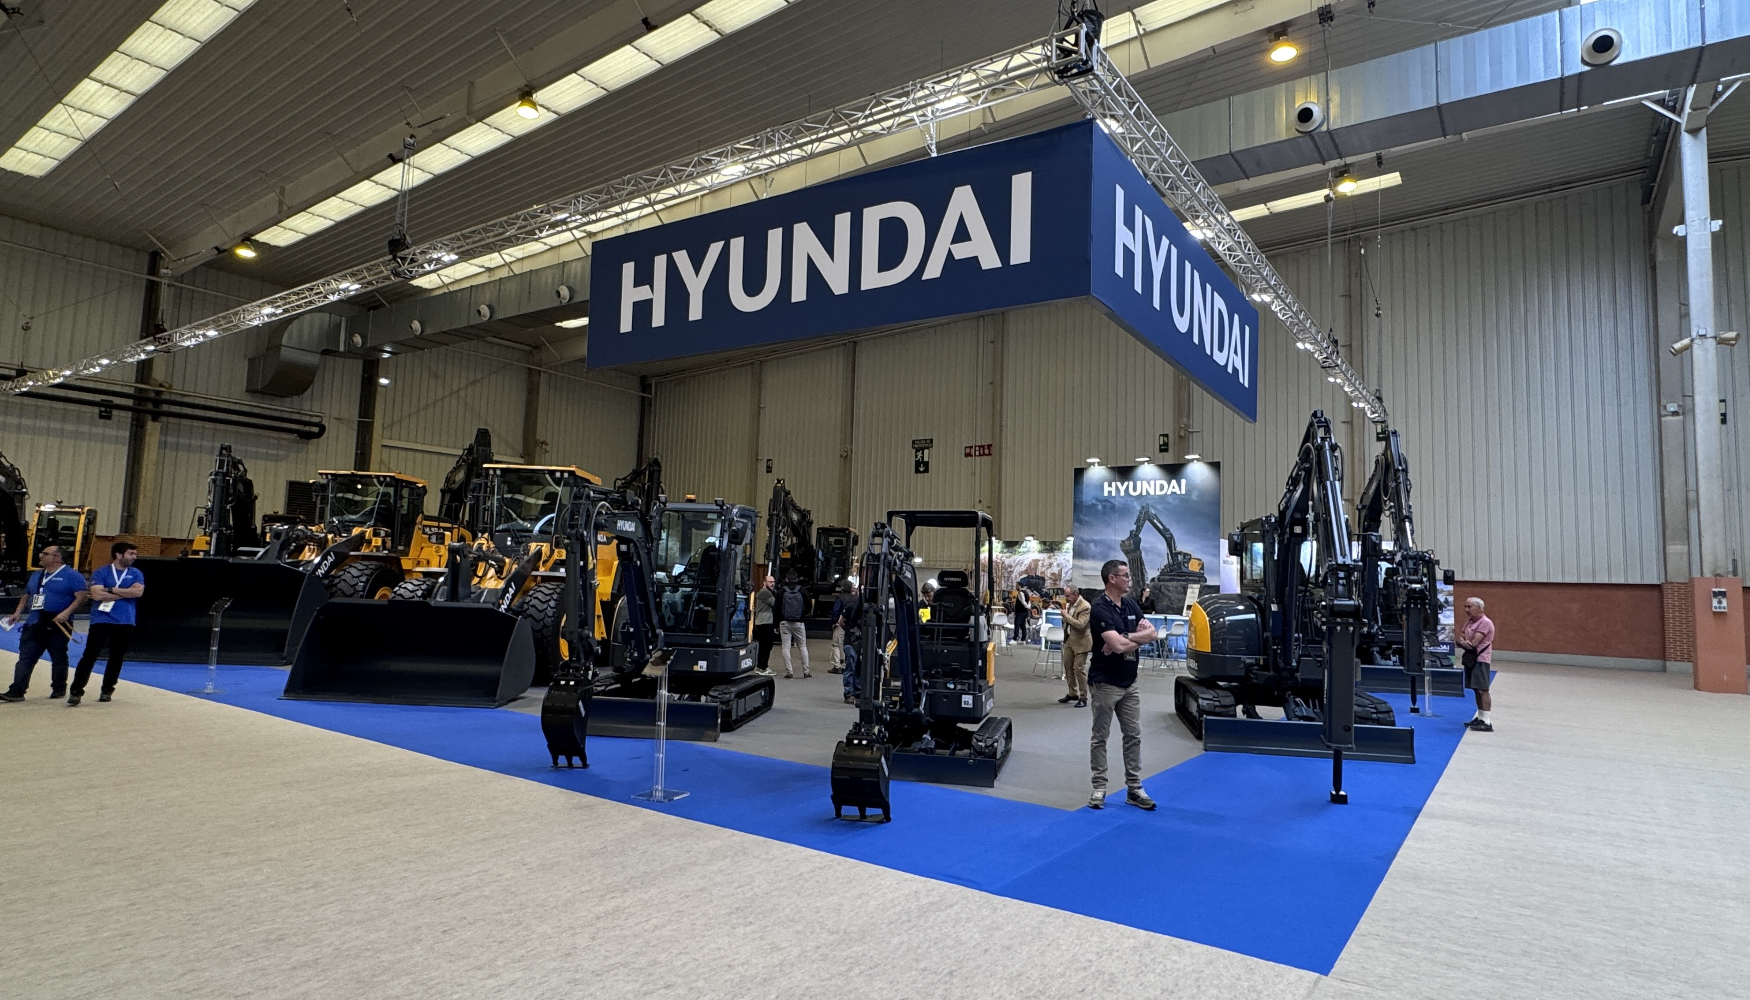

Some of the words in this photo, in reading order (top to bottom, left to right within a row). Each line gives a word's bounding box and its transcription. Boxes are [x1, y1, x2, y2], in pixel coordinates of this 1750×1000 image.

[619, 171, 1032, 334] HYUNDAI
[1114, 184, 1252, 387] HYUNDAI
[616, 520, 636, 532] HYUNDAI
[1103, 479, 1186, 497] HYUNDAI
